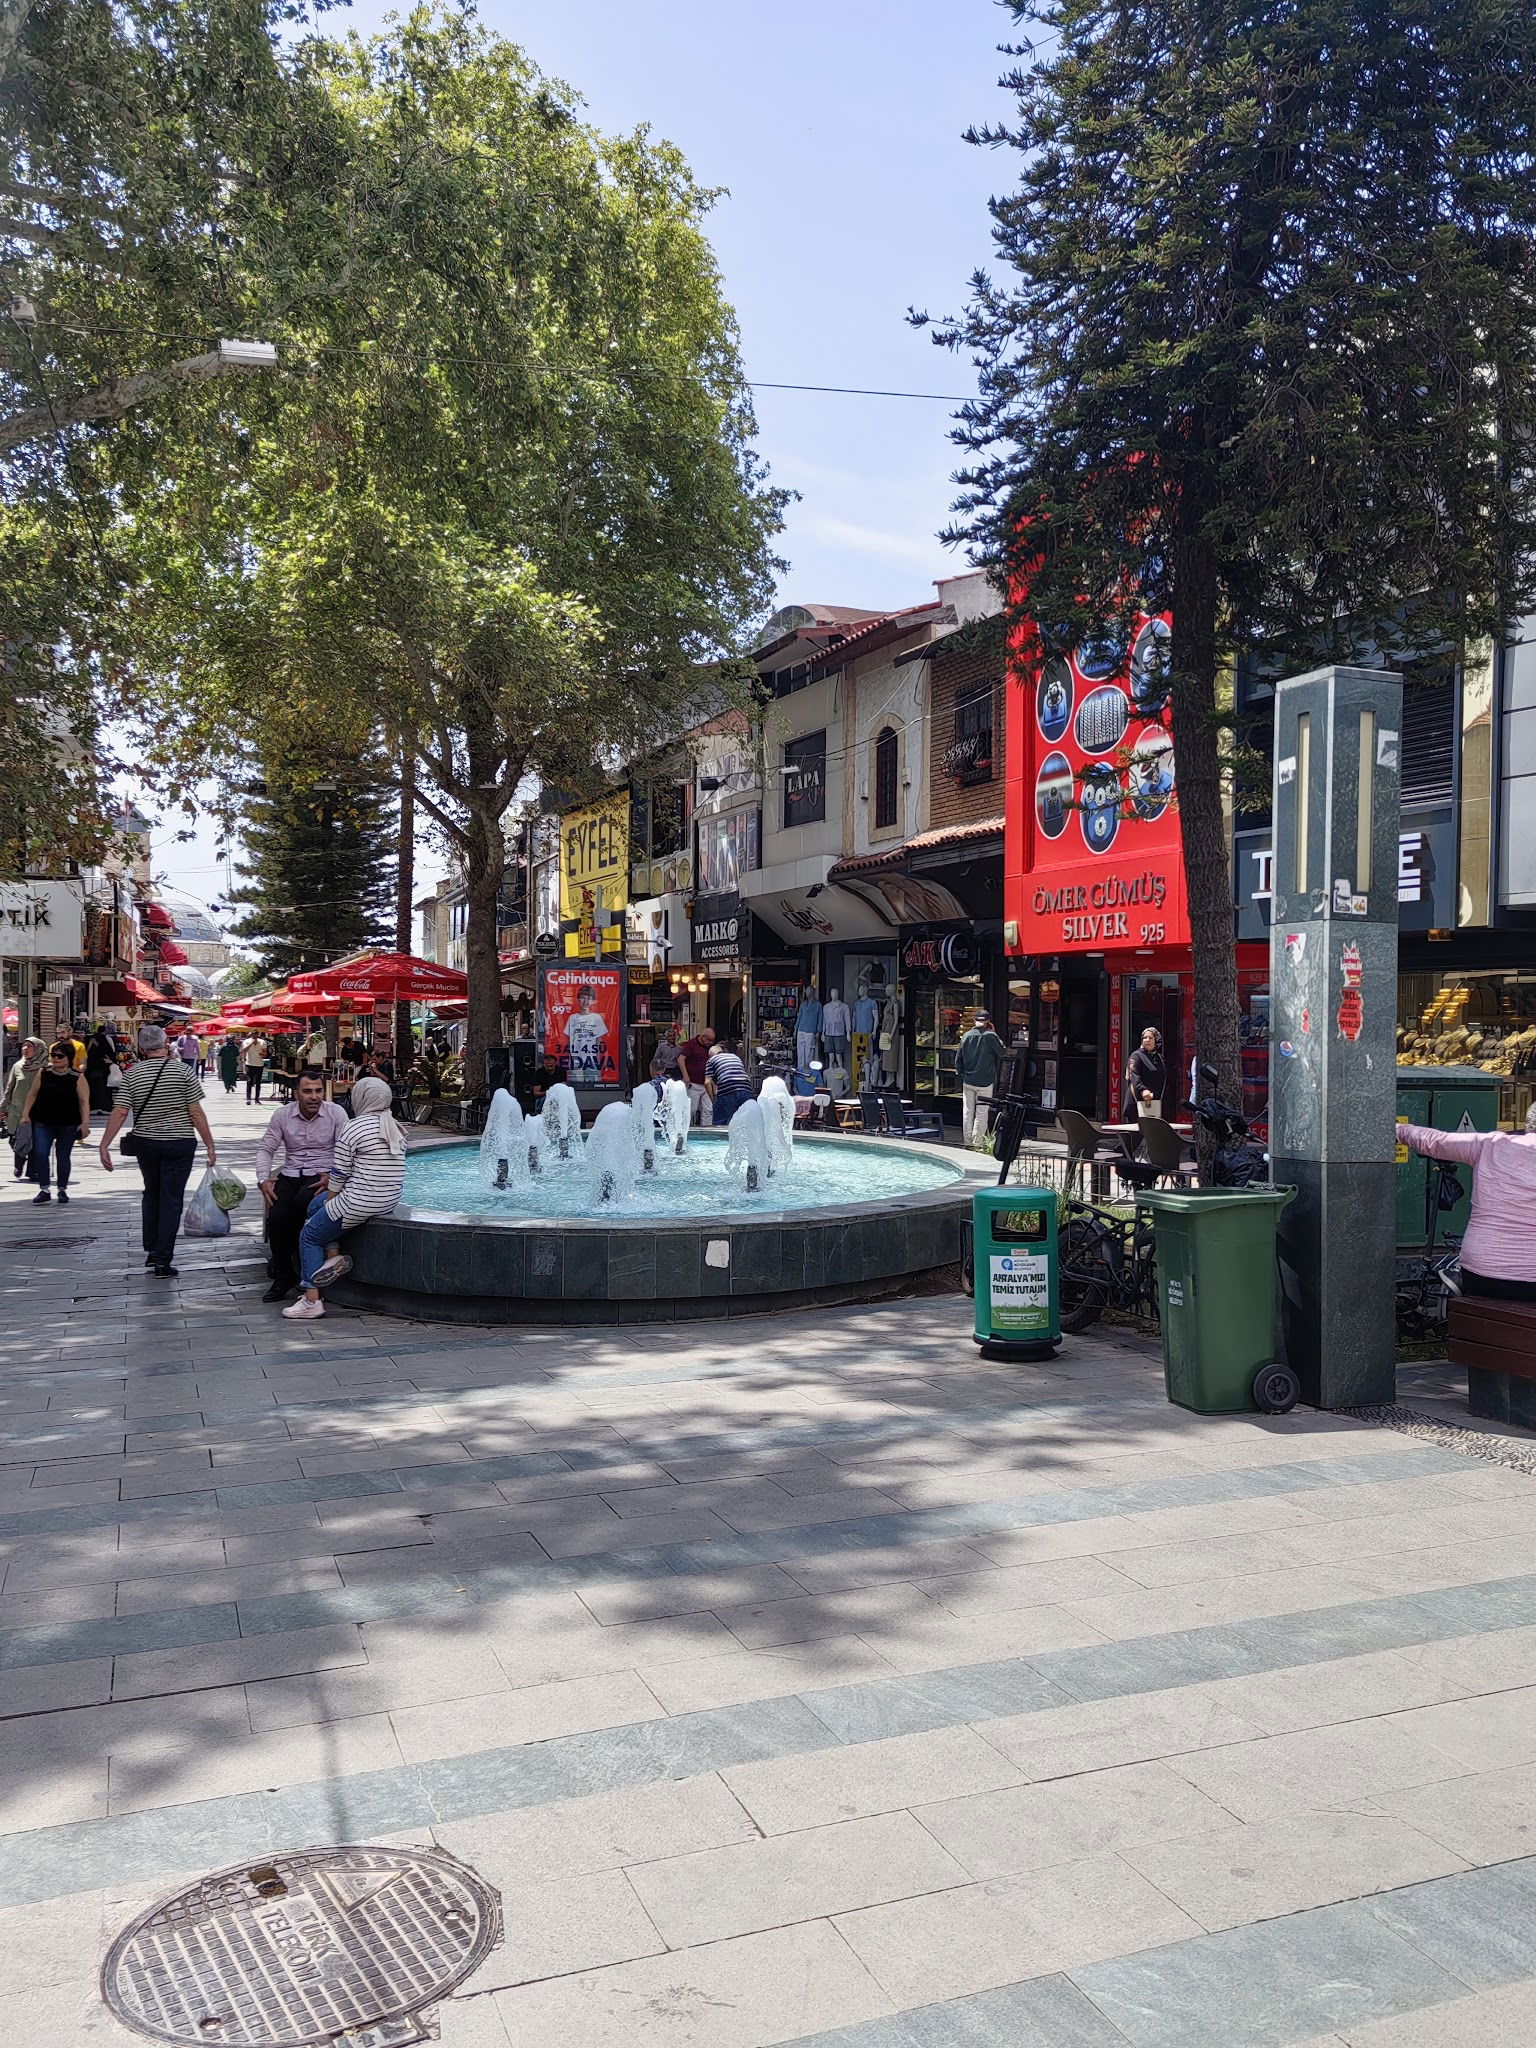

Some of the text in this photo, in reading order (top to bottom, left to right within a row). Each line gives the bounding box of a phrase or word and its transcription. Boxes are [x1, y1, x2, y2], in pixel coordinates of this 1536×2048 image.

[787, 770, 820, 794] LAPA
[568, 813, 618, 878] EYFEL
[1032, 871, 1166, 914] ÖMER GÜMÜŞ
[694, 917, 739, 943] MARK@
[1062, 911, 1165, 944] SILVER 925
[701, 943, 739, 959] ACCESSORIES
[410, 981, 460, 992] Gerçek Mucize
[555, 1044, 562, 1054] 3
[563, 1044, 578, 1054] AL
[559, 1055, 617, 1071] EDAVA
[1111, 1032, 1120, 1119] SILVER
[992, 1273, 1046, 1283] ANTALYA'MIZI
[992, 1284, 1047, 1295] TEMİZ TUTALIM
[260, 1907, 322, 1983] TELEKOM
[294, 1910, 341, 1960] TÜRK
